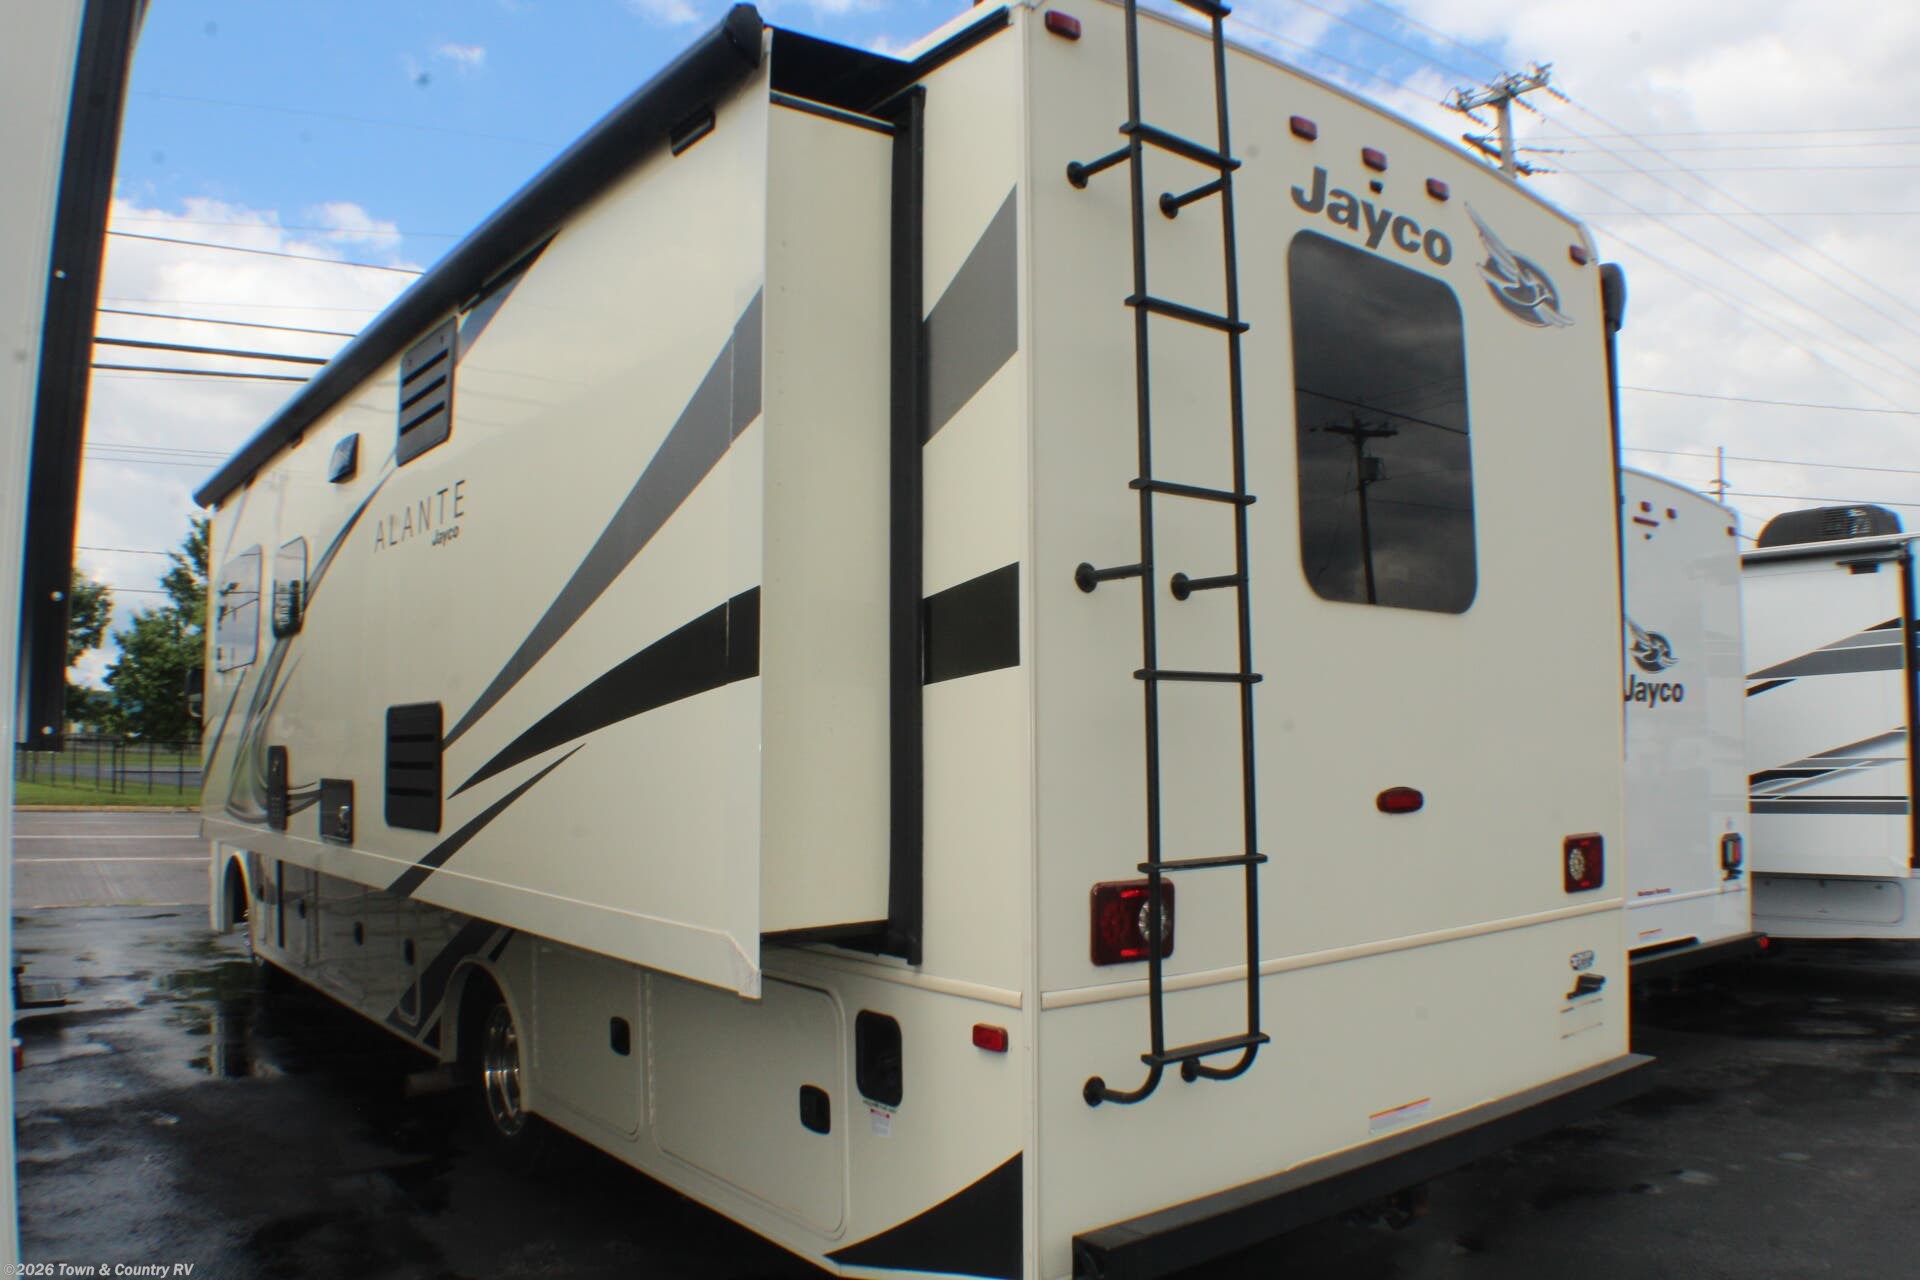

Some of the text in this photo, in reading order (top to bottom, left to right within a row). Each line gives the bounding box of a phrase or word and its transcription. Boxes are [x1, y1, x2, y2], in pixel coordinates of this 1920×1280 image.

[1290, 165, 1452, 266] Jayco
[374, 479, 466, 553] ALANTE
[1624, 674, 1684, 709] Jayco
